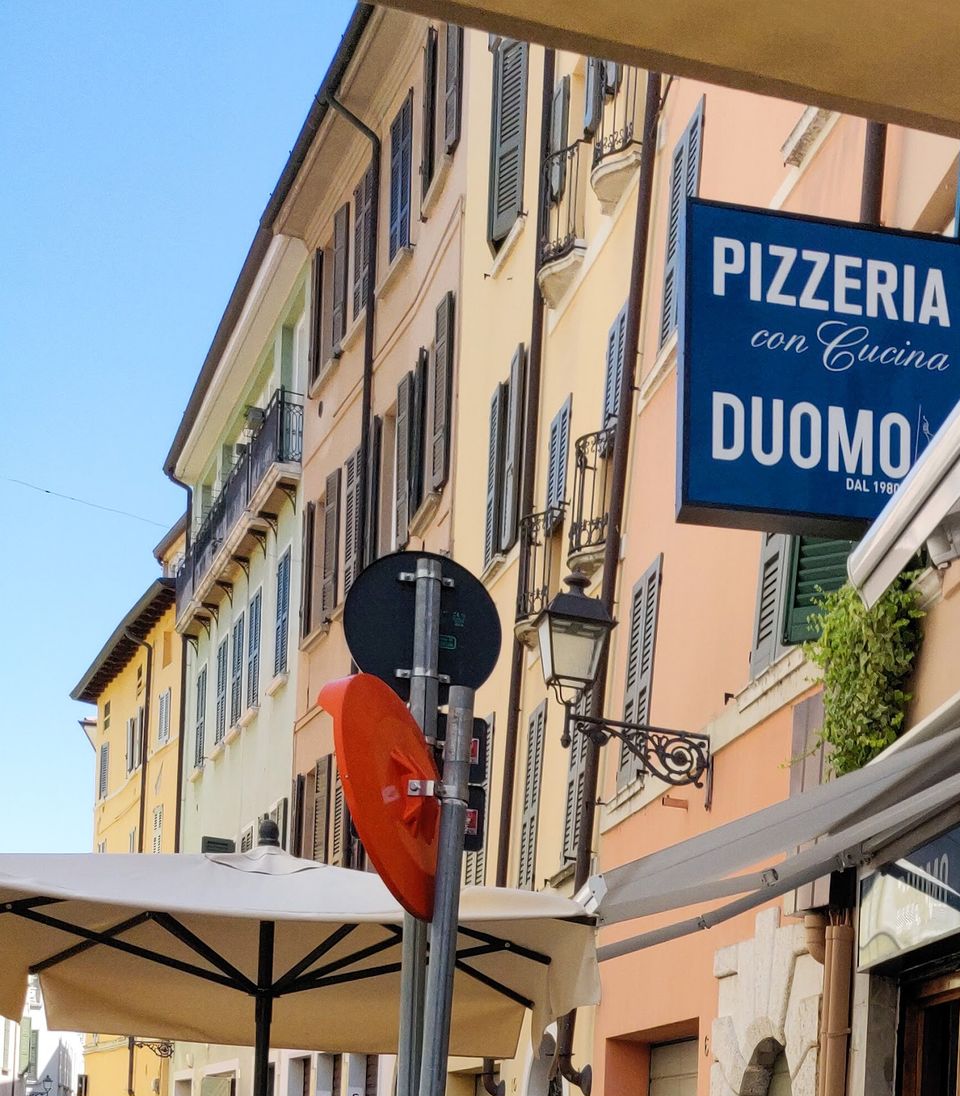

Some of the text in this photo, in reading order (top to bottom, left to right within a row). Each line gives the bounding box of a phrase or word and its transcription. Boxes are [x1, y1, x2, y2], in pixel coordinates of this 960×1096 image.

[712, 236, 951, 328] PIZZERIA
[751, 320, 950, 372] con Cucina
[712, 391, 912, 479] DUOMO
[846, 477, 900, 495] DAL 1980
